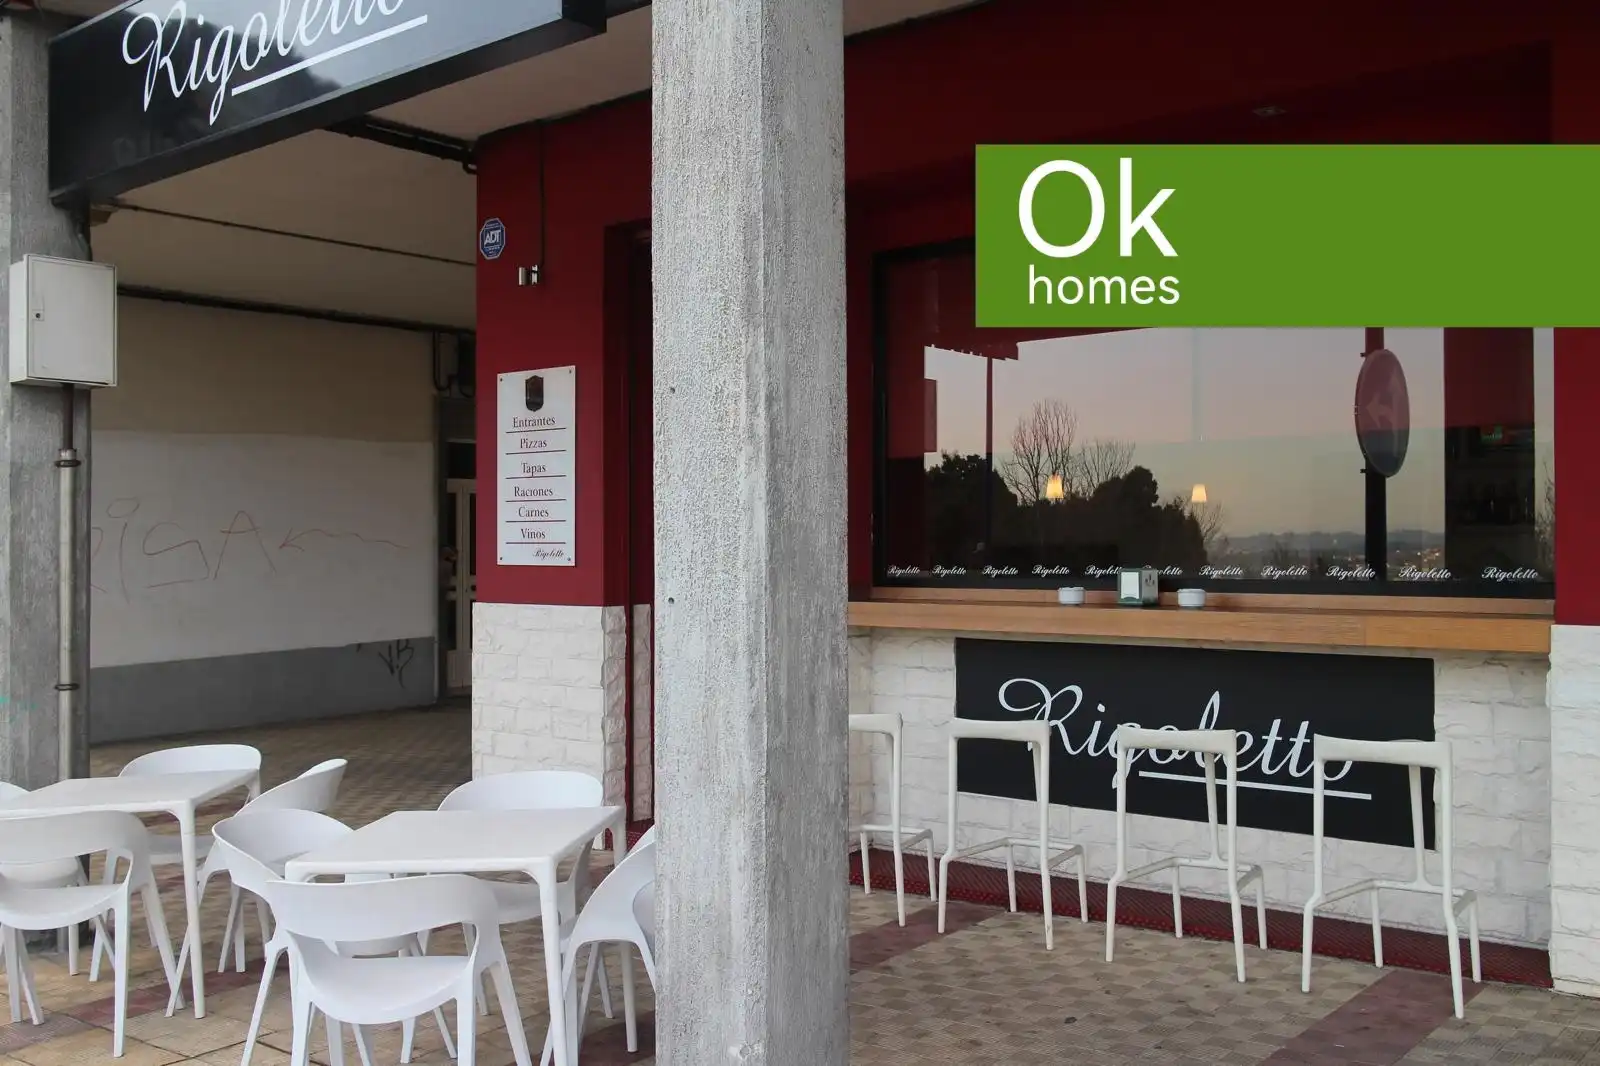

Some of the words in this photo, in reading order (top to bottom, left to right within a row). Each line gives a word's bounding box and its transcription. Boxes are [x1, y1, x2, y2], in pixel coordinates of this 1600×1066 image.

[484, 230, 501, 246] ADT
[513, 415, 556, 428] Entrantes
[520, 437, 548, 449] Pizzas
[521, 462, 547, 477] Tapas
[514, 485, 554, 497] Raciones
[518, 505, 550, 518] Carnes
[521, 527, 546, 539] Vinos
[887, 564, 921, 576] Rigoletto
[932, 564, 967, 576] Rigoletto
[982, 565, 1019, 577] Rigoletto
[1032, 564, 1070, 576] Rigoletto
[1199, 565, 1243, 577] Rigoletto
[1261, 565, 1308, 578] Rigoletto
[1326, 565, 1376, 580] Rigoletto
[1398, 565, 1452, 581] Rigoletto
[1481, 566, 1538, 582] Rigoletto
